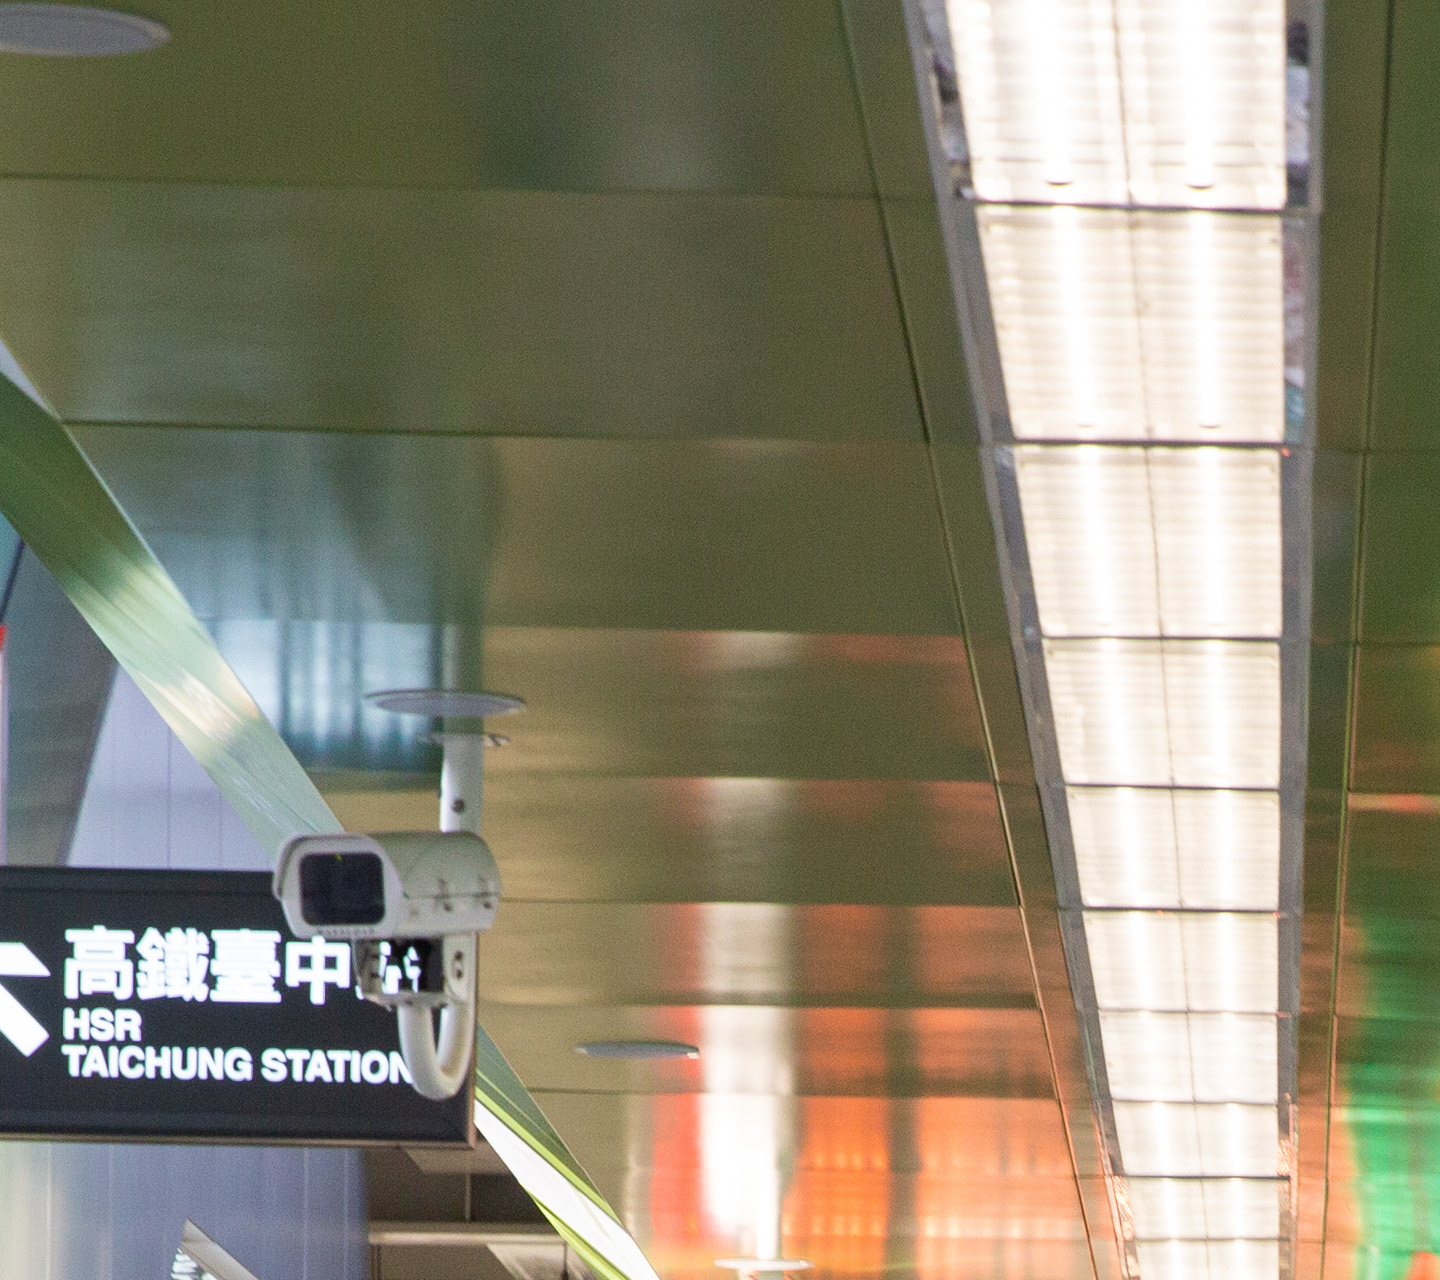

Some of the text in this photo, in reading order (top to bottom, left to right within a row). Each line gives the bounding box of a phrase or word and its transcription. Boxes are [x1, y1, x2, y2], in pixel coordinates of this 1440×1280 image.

[63, 1007, 143, 1041] HSR
[61, 1045, 413, 1084] TAICHUNG STATION
